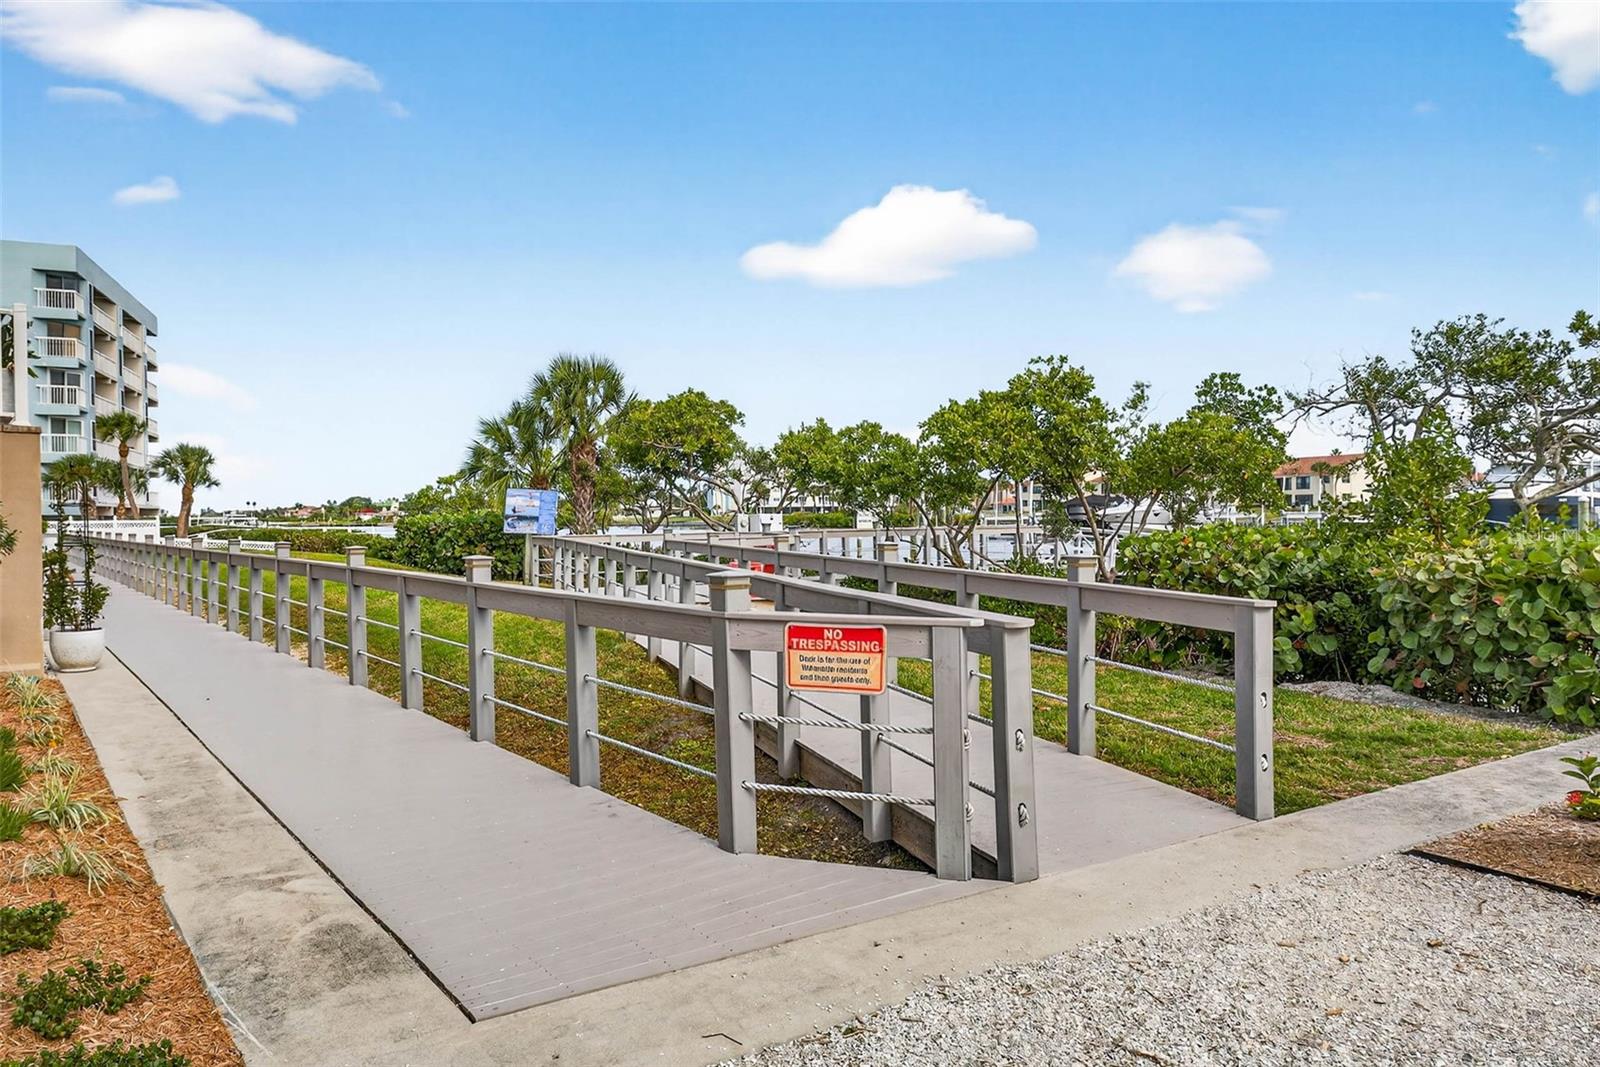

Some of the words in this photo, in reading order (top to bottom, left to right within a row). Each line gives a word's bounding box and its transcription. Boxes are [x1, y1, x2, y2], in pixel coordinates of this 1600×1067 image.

[823, 629, 843, 640] NO
[791, 638, 881, 652] TRESPASSING
[863, 657, 871, 665] of
